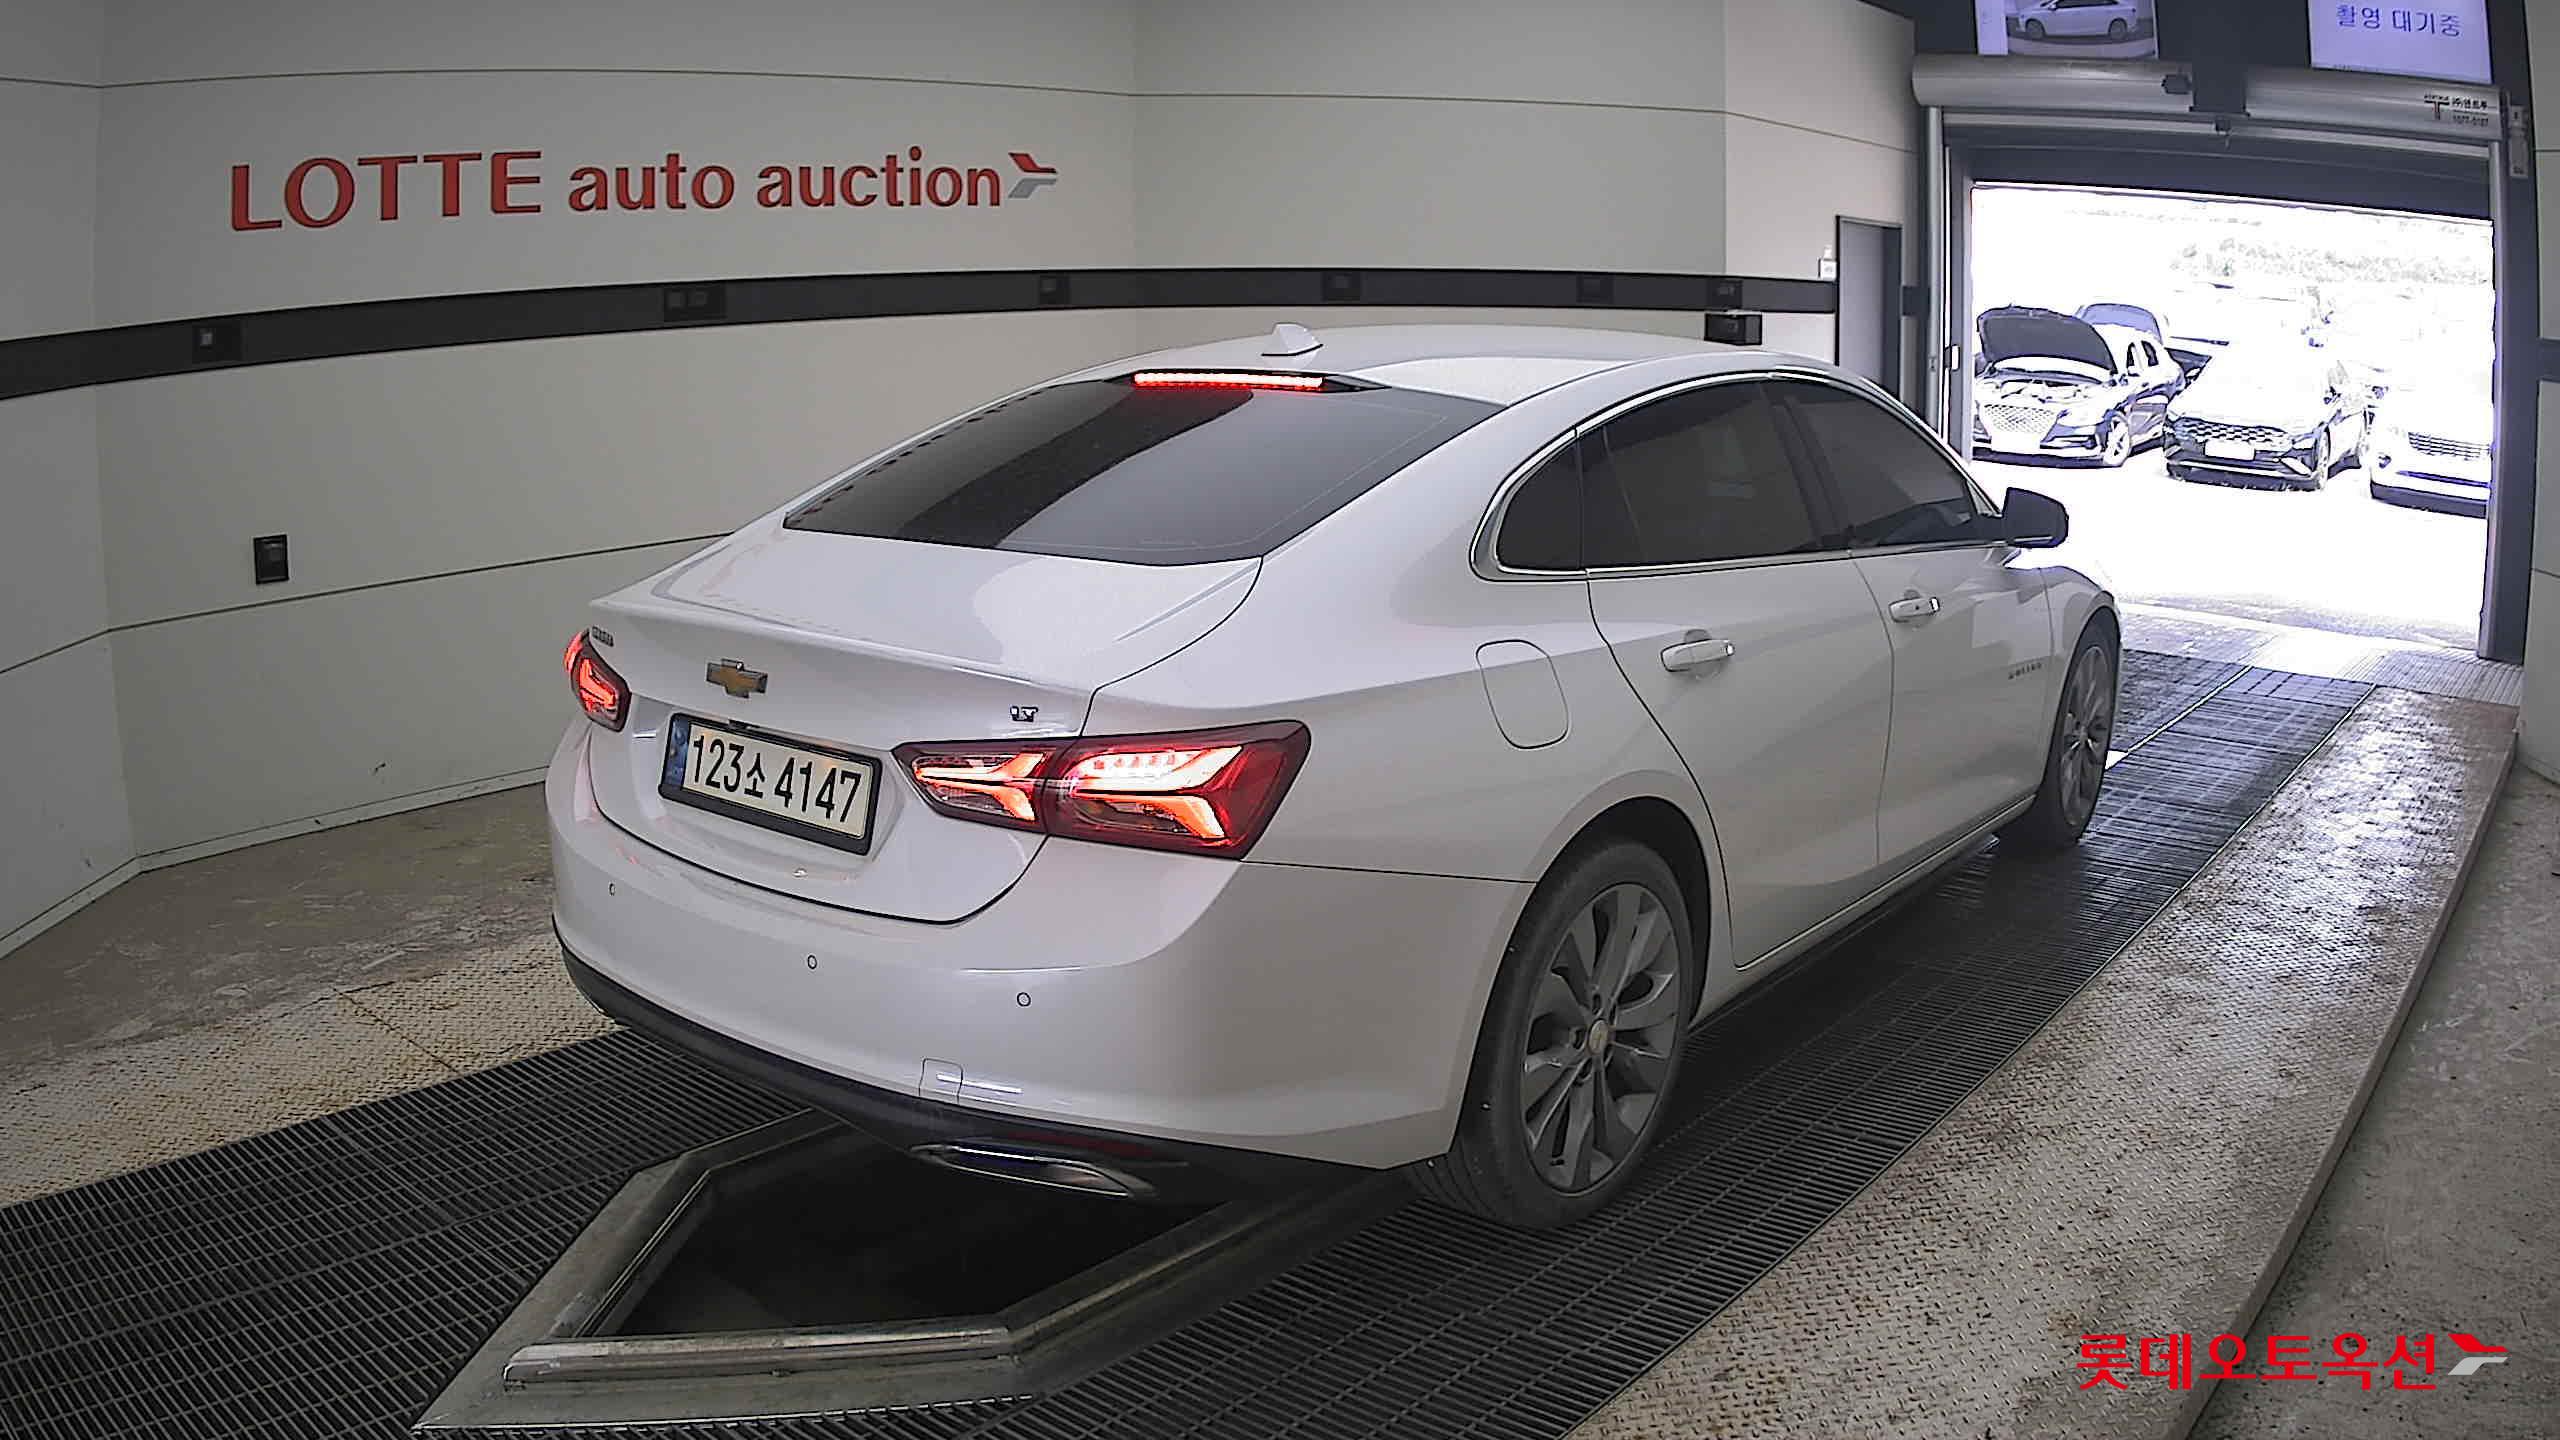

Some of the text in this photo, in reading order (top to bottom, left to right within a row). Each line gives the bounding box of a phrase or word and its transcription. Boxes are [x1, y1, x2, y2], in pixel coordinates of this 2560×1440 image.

[2337, 4, 2460, 37] 촬영 대기중
[231, 146, 1001, 231] LOTTE auto auction
[774, 757, 862, 823] 4147
